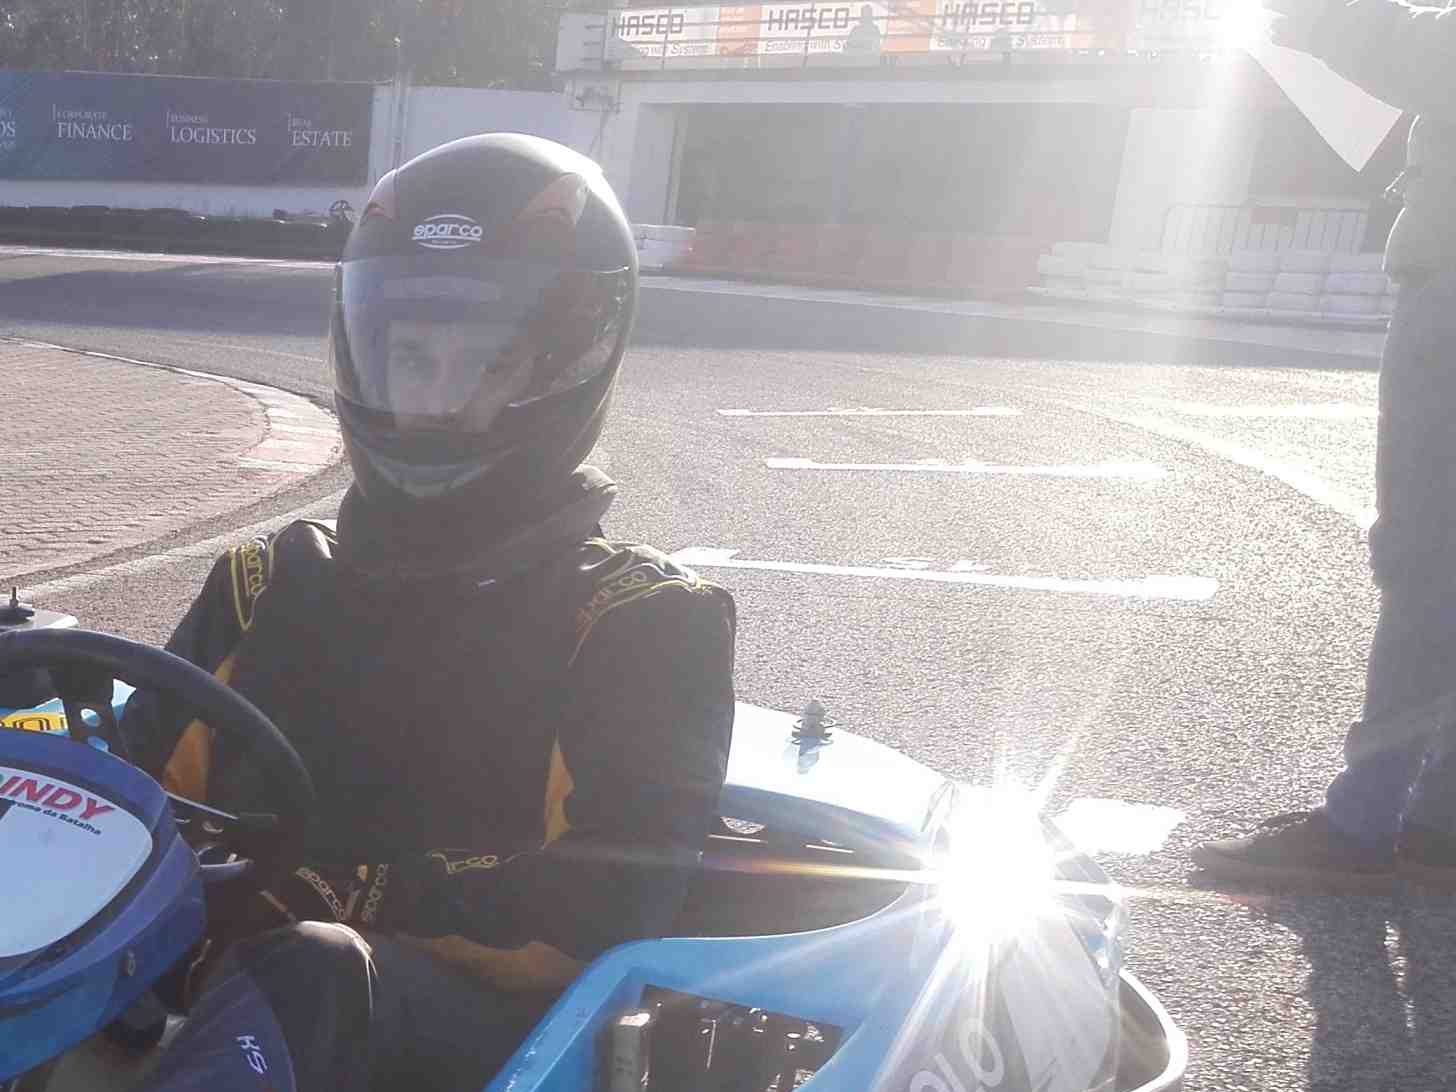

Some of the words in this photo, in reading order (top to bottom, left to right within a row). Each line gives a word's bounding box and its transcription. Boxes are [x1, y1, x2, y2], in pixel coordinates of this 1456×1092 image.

[768, 7, 849, 32] HASCO
[56, 121, 132, 142] FINANCE
[169, 126, 257, 145] LOGISTICS
[292, 130, 353, 148] ESTATE
[413, 222, 483, 239] sparco
[59, 812, 102, 836] Batalha
